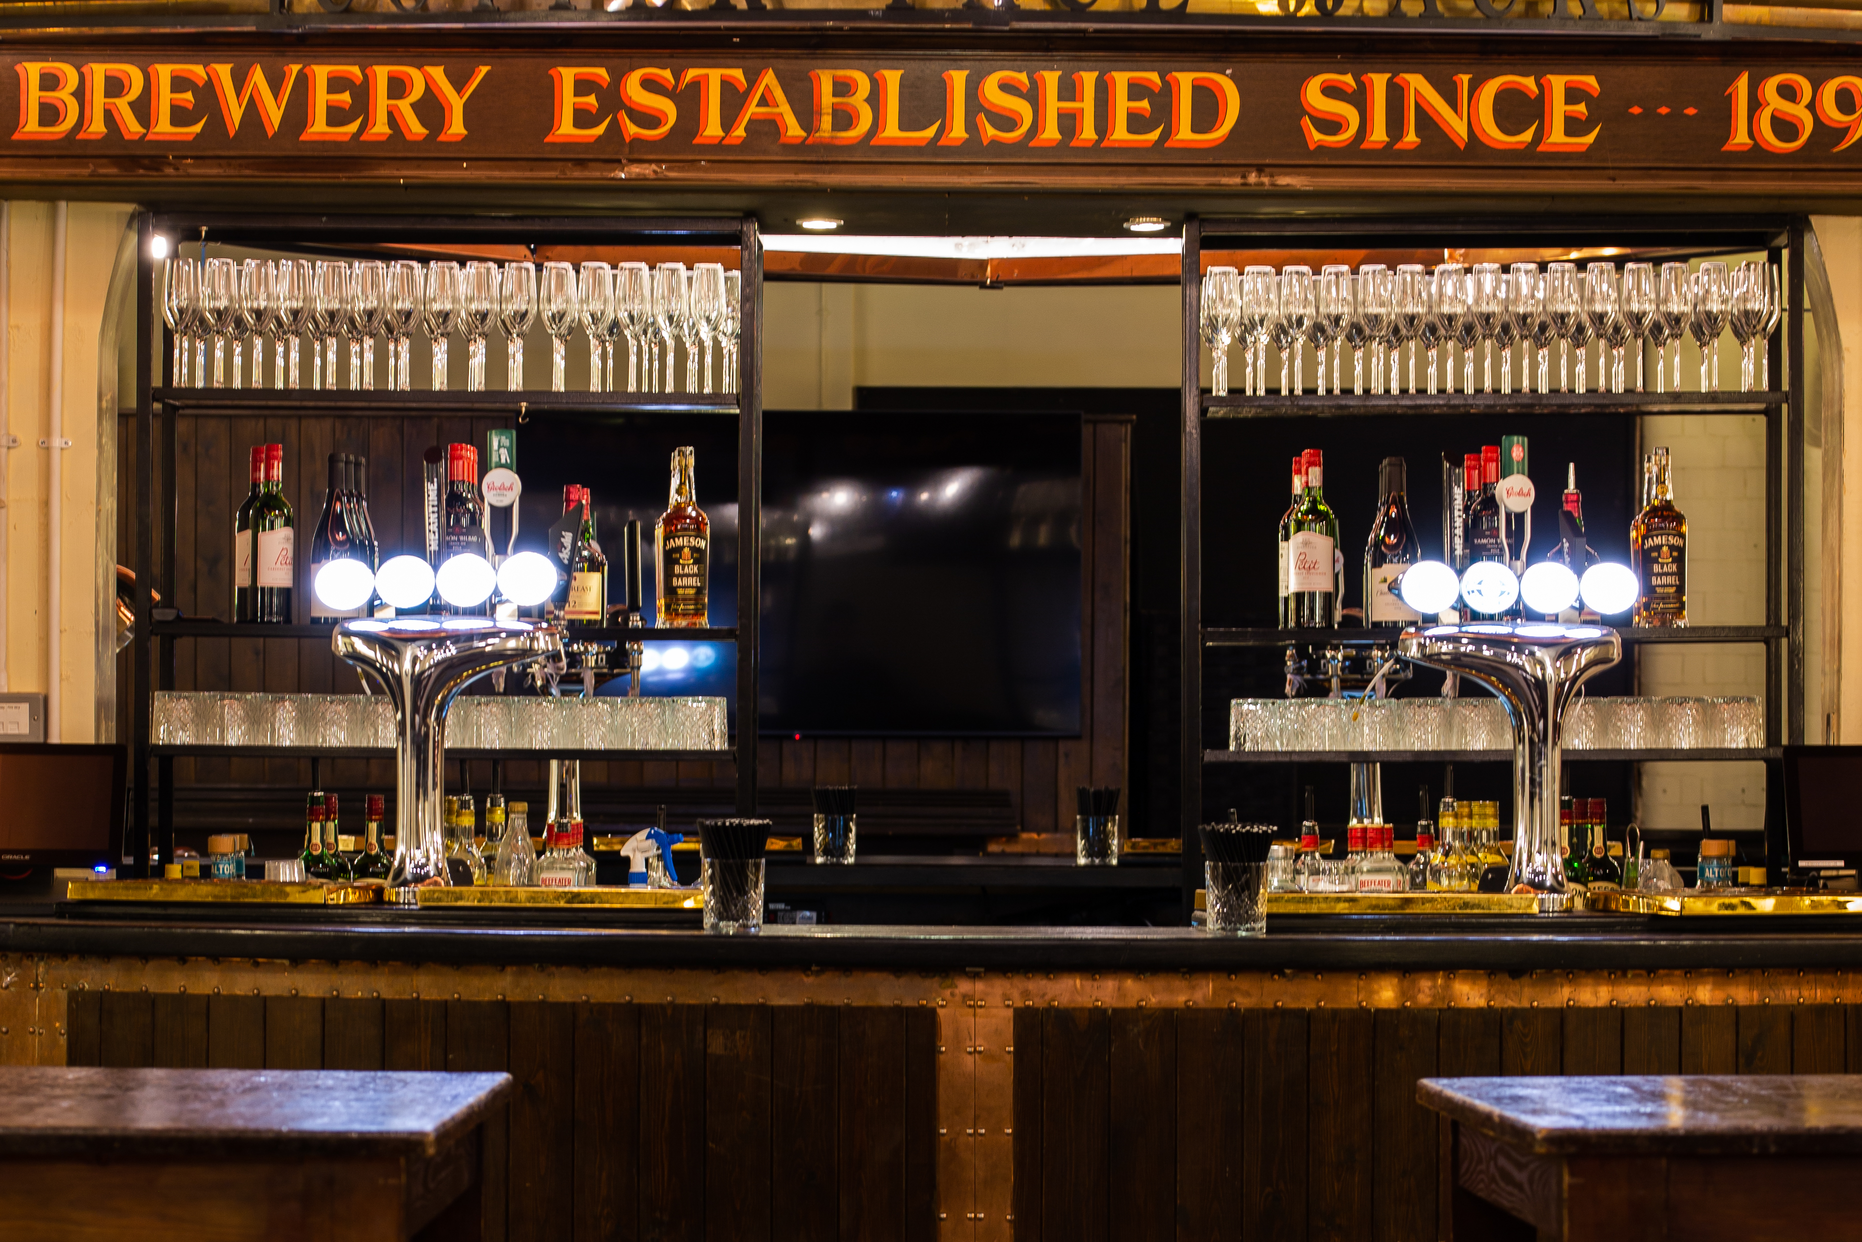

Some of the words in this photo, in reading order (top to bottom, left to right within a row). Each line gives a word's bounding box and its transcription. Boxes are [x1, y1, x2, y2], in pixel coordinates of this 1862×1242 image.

[11, 61, 492, 142] BREWERY
[544, 66, 1241, 149] ESTABLISHED
[1300, 72, 1602, 152] SINCE
[1721, 70, 1862, 154] 189
[1505, 486, 1532, 499] Grolsch
[558, 530, 574, 565] Asahi
[665, 536, 707, 551] JAMESON
[1643, 534, 1685, 550] JAMESON
[674, 564, 699, 575] BLACK
[1653, 563, 1678, 573] BLACK
[672, 576, 701, 587] BARREL
[1651, 575, 1680, 586] BARREL
[1, 853, 31, 861] ORACLE
[541, 876, 572, 887] BEEFEATER
[1359, 878, 1392, 889] BEEFEATER
